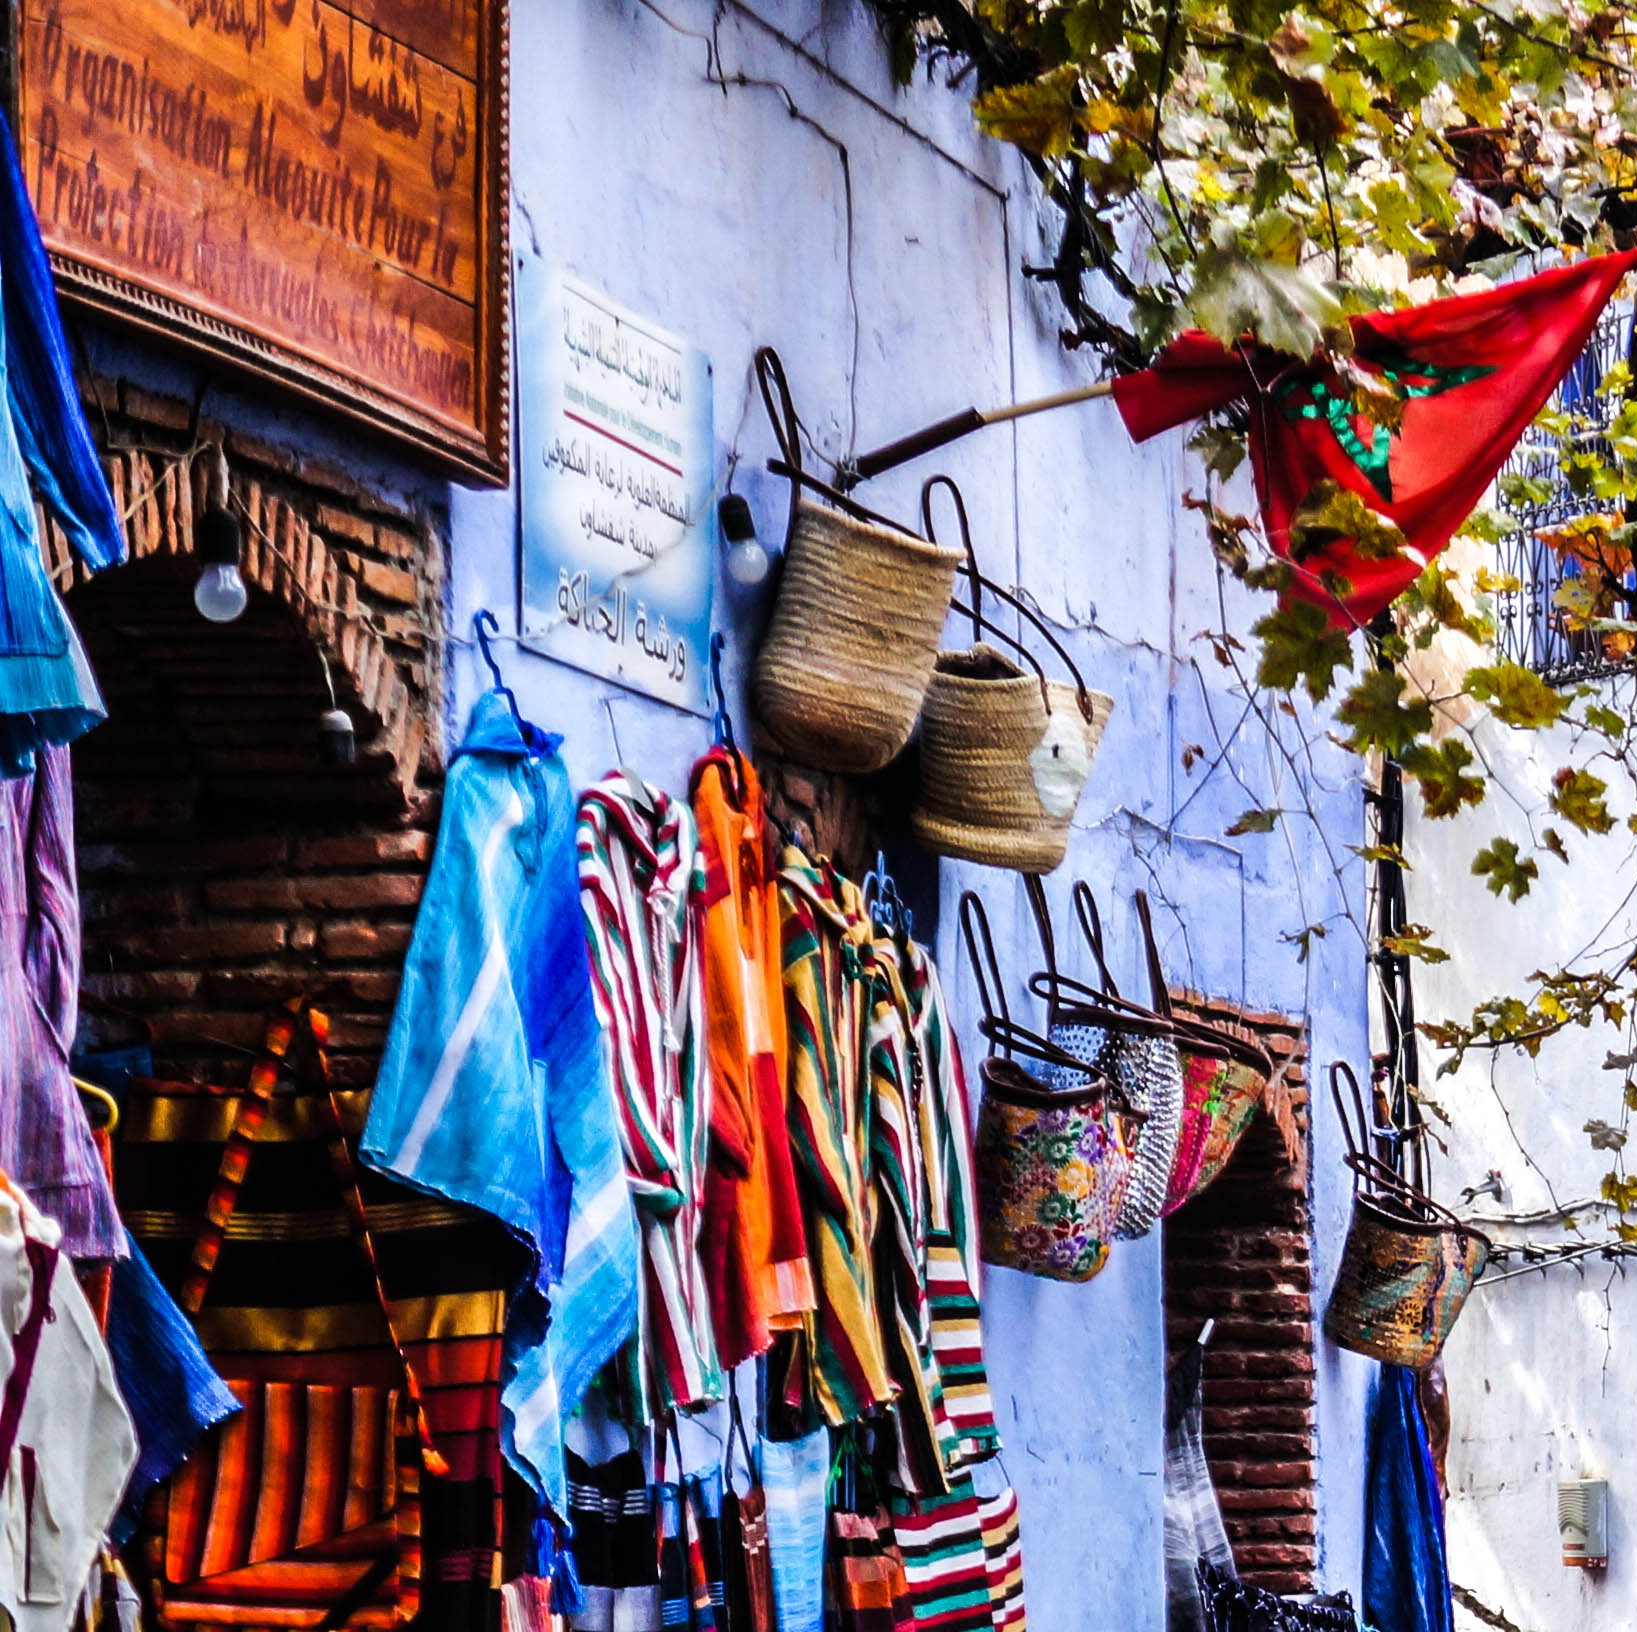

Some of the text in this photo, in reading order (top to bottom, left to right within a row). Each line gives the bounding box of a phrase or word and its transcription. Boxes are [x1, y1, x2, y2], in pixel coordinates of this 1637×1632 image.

[36, 101, 185, 284] Protection
[42, 2, 232, 181] Organisation
[244, 99, 366, 245] Alaouite
[635, 603, 687, 682] ورشة
